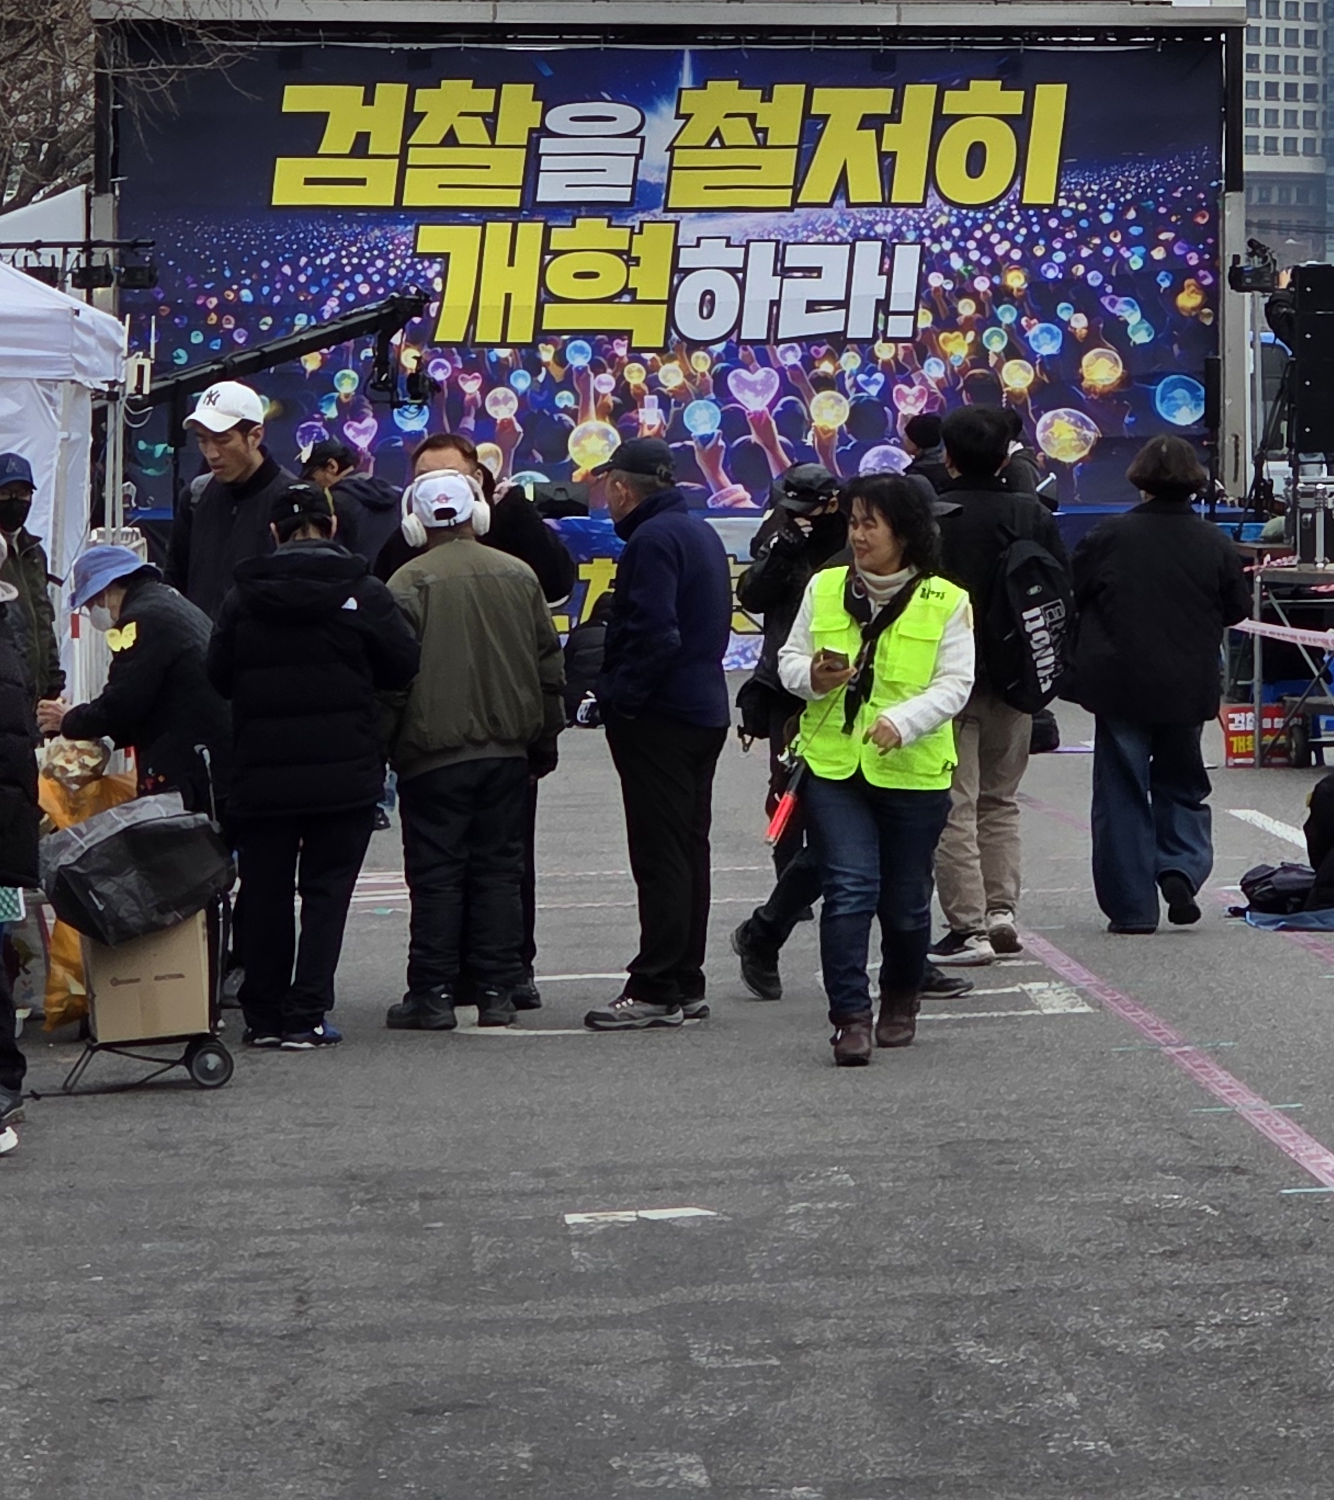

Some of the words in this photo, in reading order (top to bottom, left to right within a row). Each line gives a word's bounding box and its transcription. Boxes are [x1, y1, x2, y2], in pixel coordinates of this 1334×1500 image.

[271, 82, 647, 209] 검찰을
[665, 80, 1068, 208] 철저히
[414, 220, 922, 348] 개혁하라!
